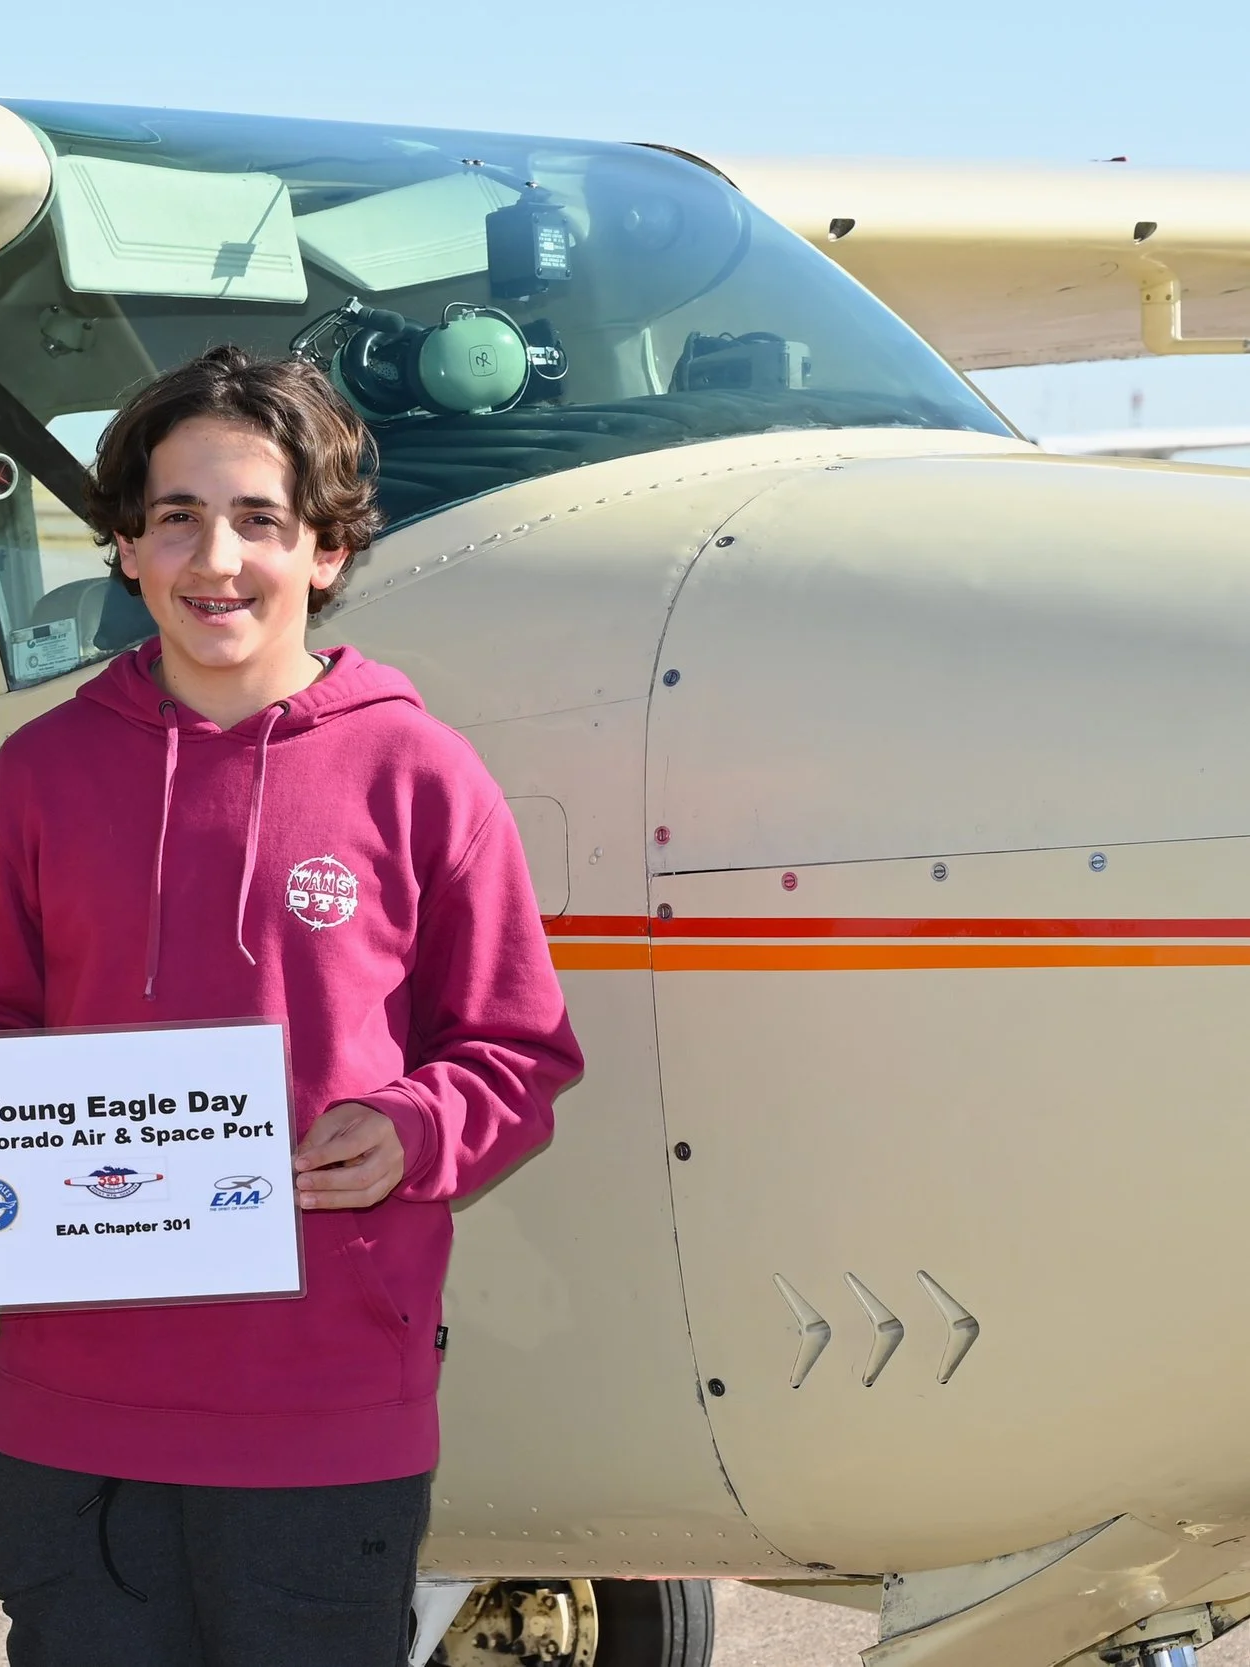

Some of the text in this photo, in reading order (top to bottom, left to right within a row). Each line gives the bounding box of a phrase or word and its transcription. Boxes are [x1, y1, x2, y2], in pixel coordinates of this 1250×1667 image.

[293, 869, 352, 896] VANS
[87, 1094, 177, 1122] Eagle
[188, 1090, 248, 1116] Day
[72, 1129, 106, 1146] Air
[114, 1128, 132, 1144] &
[140, 1126, 215, 1146] Space
[223, 1121, 274, 1139] Port
[210, 1190, 260, 1207] EAA
[56, 1218, 191, 1236] EAA Chapter 301
